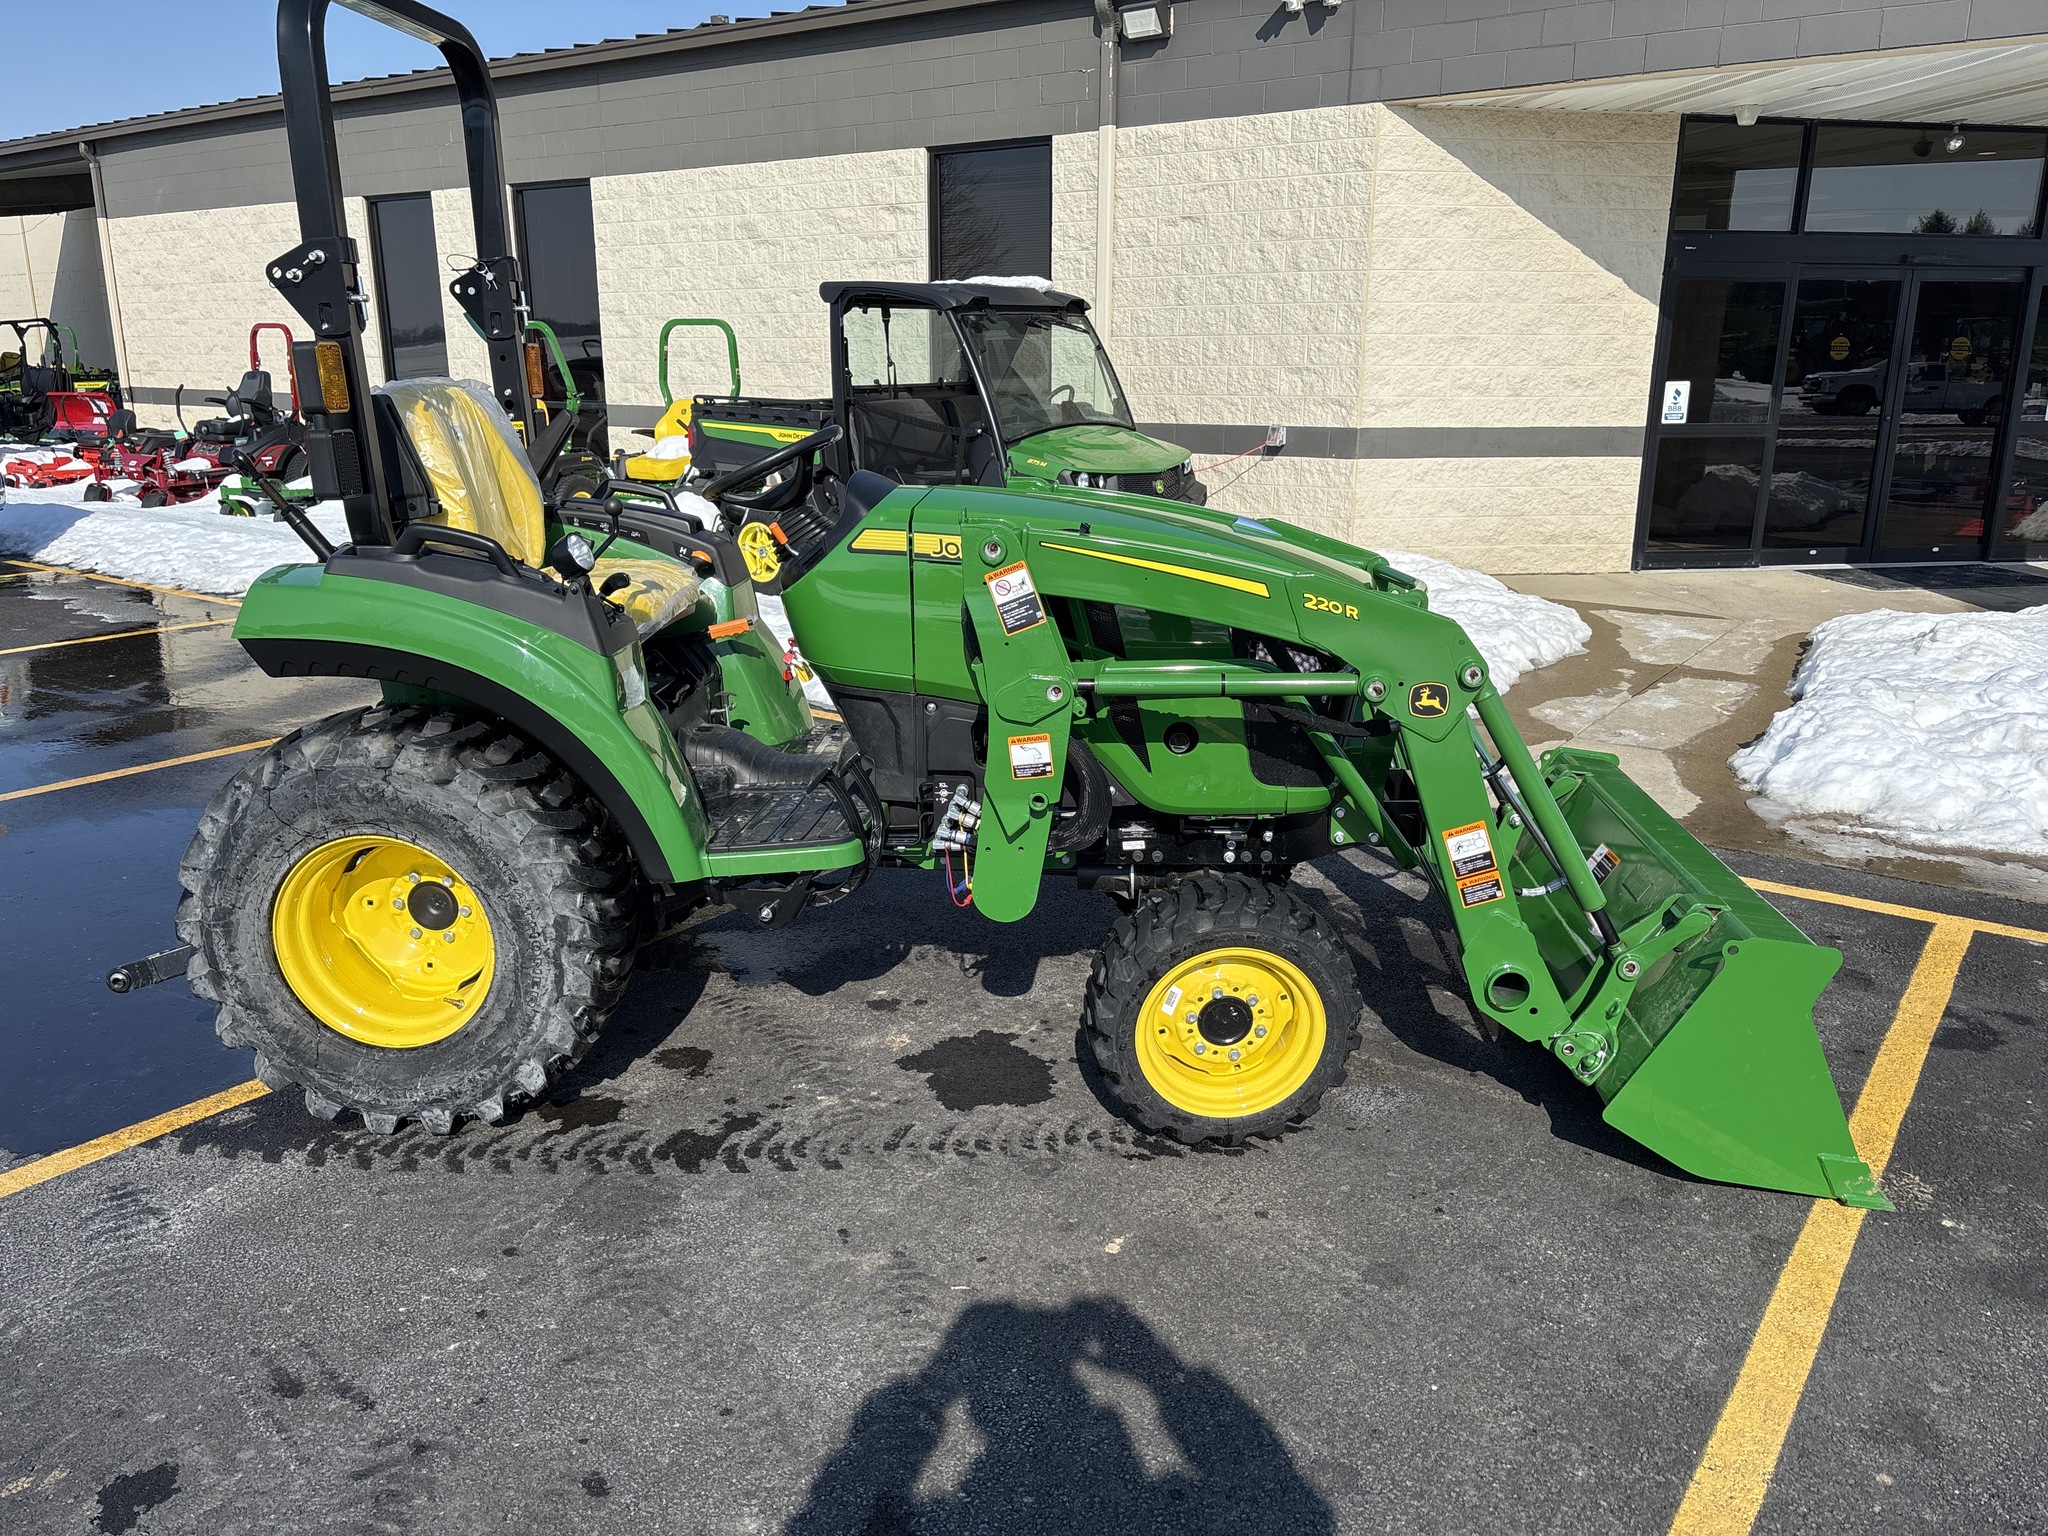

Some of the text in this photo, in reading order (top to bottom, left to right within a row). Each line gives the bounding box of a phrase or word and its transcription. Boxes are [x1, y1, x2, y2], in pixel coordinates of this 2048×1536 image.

[993, 562, 1024, 578] WARNING
[1016, 735, 1048, 743] WARNING
[1454, 824, 1481, 835] WARNING
[1468, 874, 1496, 884] WARNING
